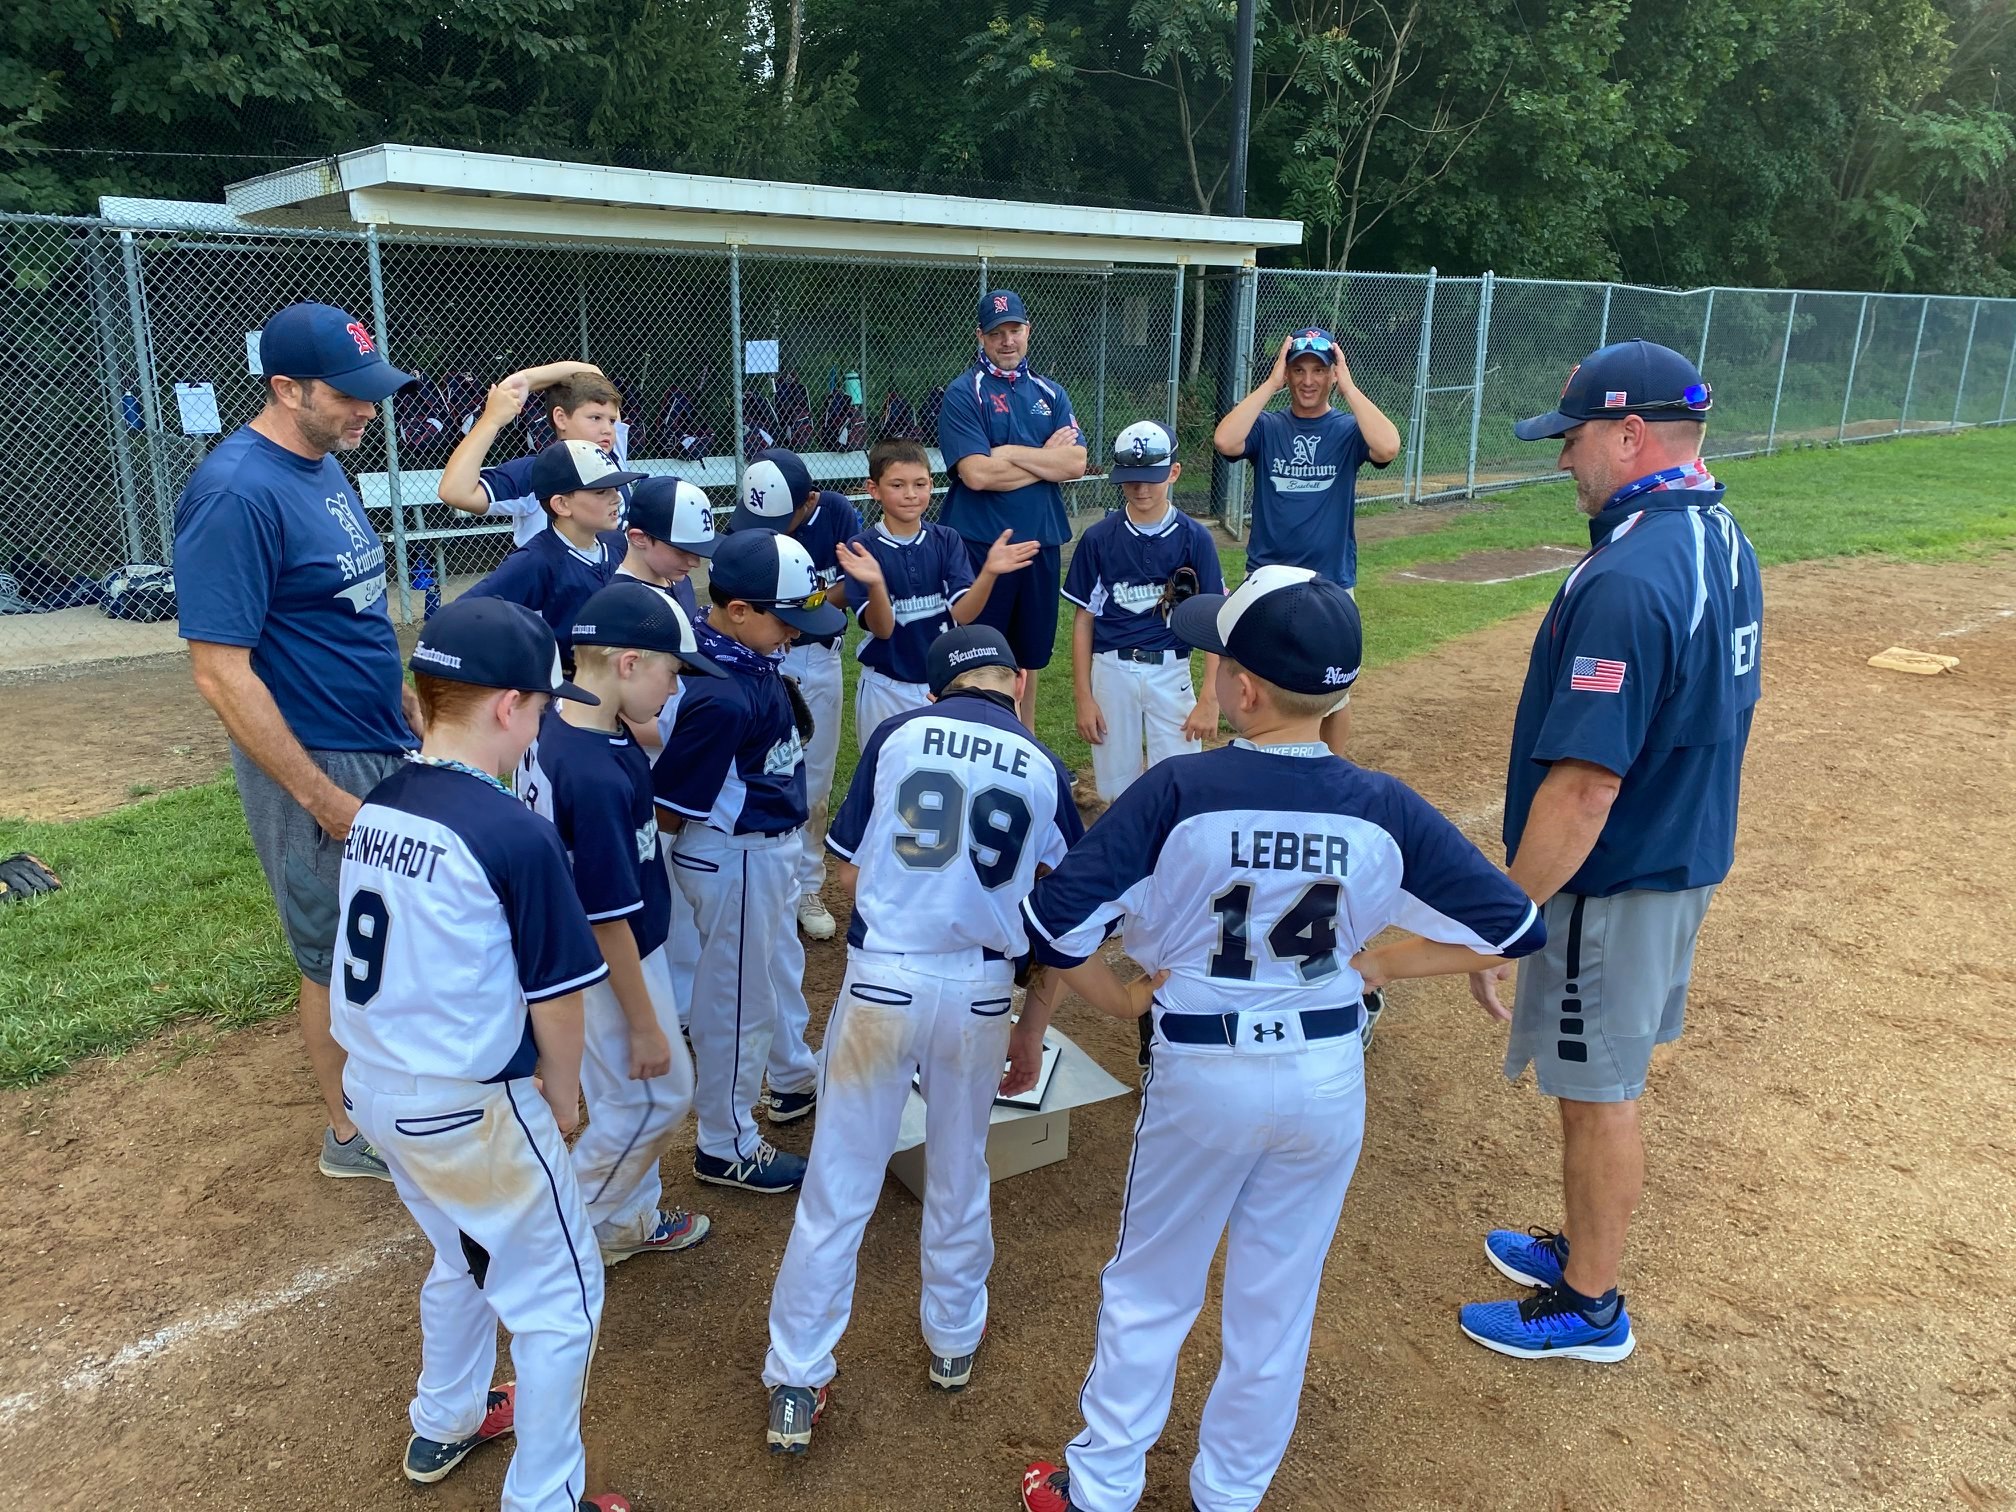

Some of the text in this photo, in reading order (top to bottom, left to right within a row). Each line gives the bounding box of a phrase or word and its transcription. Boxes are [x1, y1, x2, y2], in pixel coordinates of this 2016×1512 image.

[1272, 458, 1337, 477] Newtown
[1291, 435, 1321, 465] N
[750, 487, 766, 510] N
[1113, 582, 1166, 604] Newto
[949, 647, 998, 666] Newtown
[923, 728, 1030, 779] RUPLE
[892, 767, 1034, 893] 99
[1231, 831, 1349, 876] LEBER
[344, 885, 394, 1011] 9
[1206, 880, 1343, 985] 14
